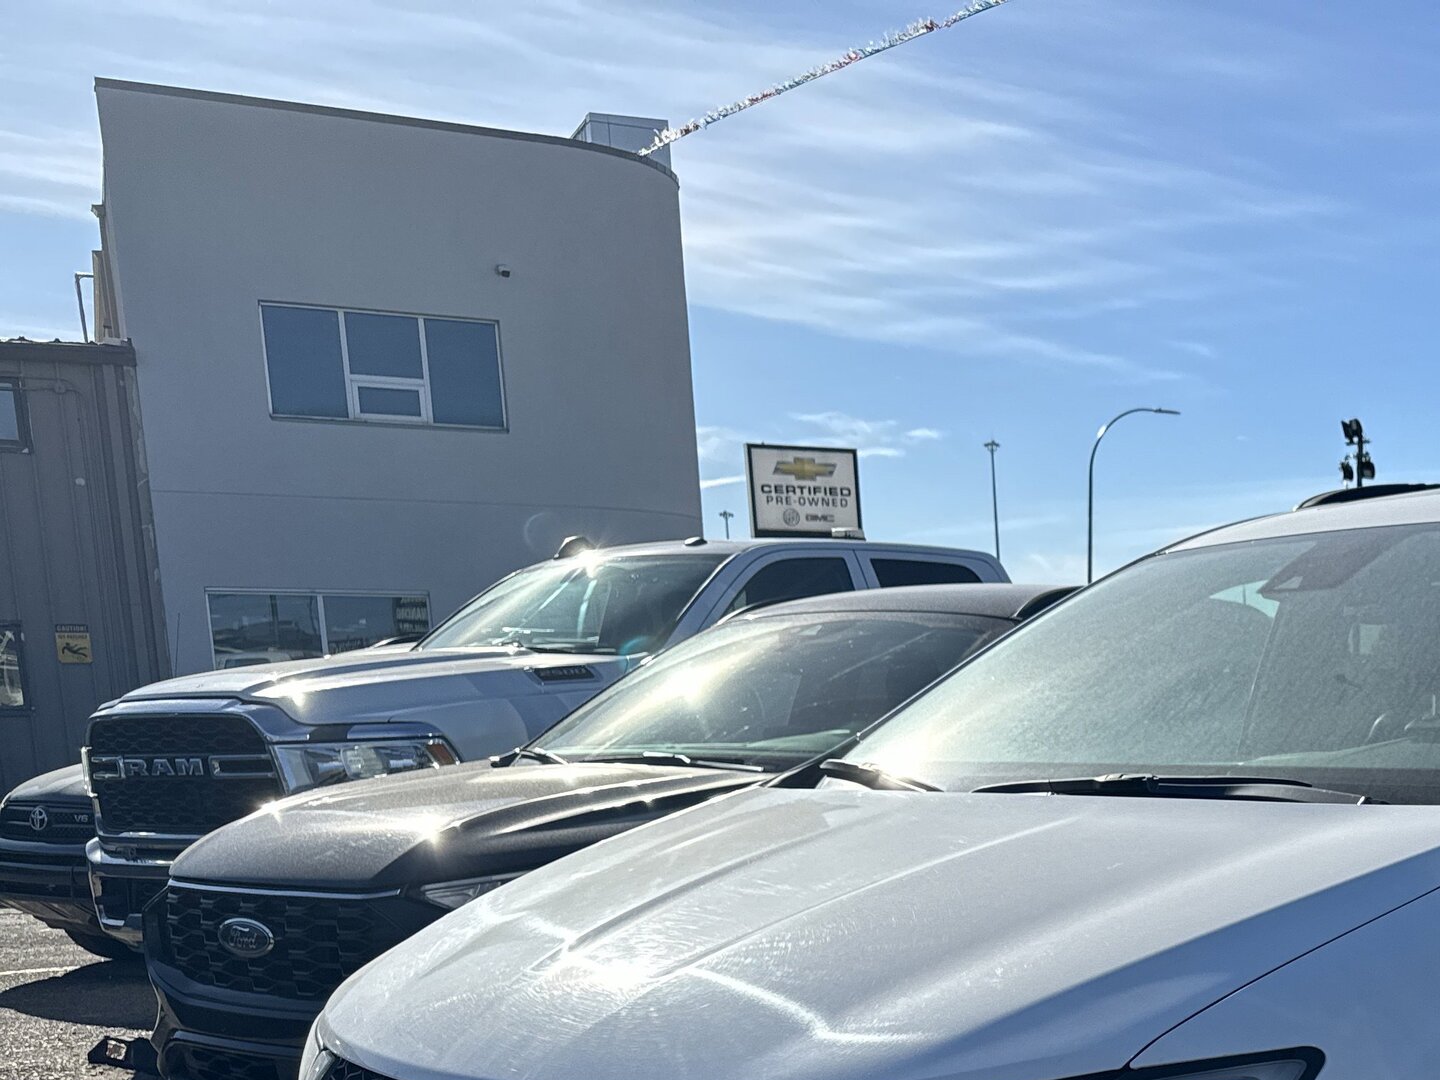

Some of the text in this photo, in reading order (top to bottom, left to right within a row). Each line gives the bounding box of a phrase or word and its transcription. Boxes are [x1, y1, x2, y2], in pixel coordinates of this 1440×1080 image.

[761, 484, 851, 497] CERTIFIED
[766, 495, 848, 508] PRE-OWNED
[124, 758, 204, 776] RAM
[229, 926, 257, 949] Ford
